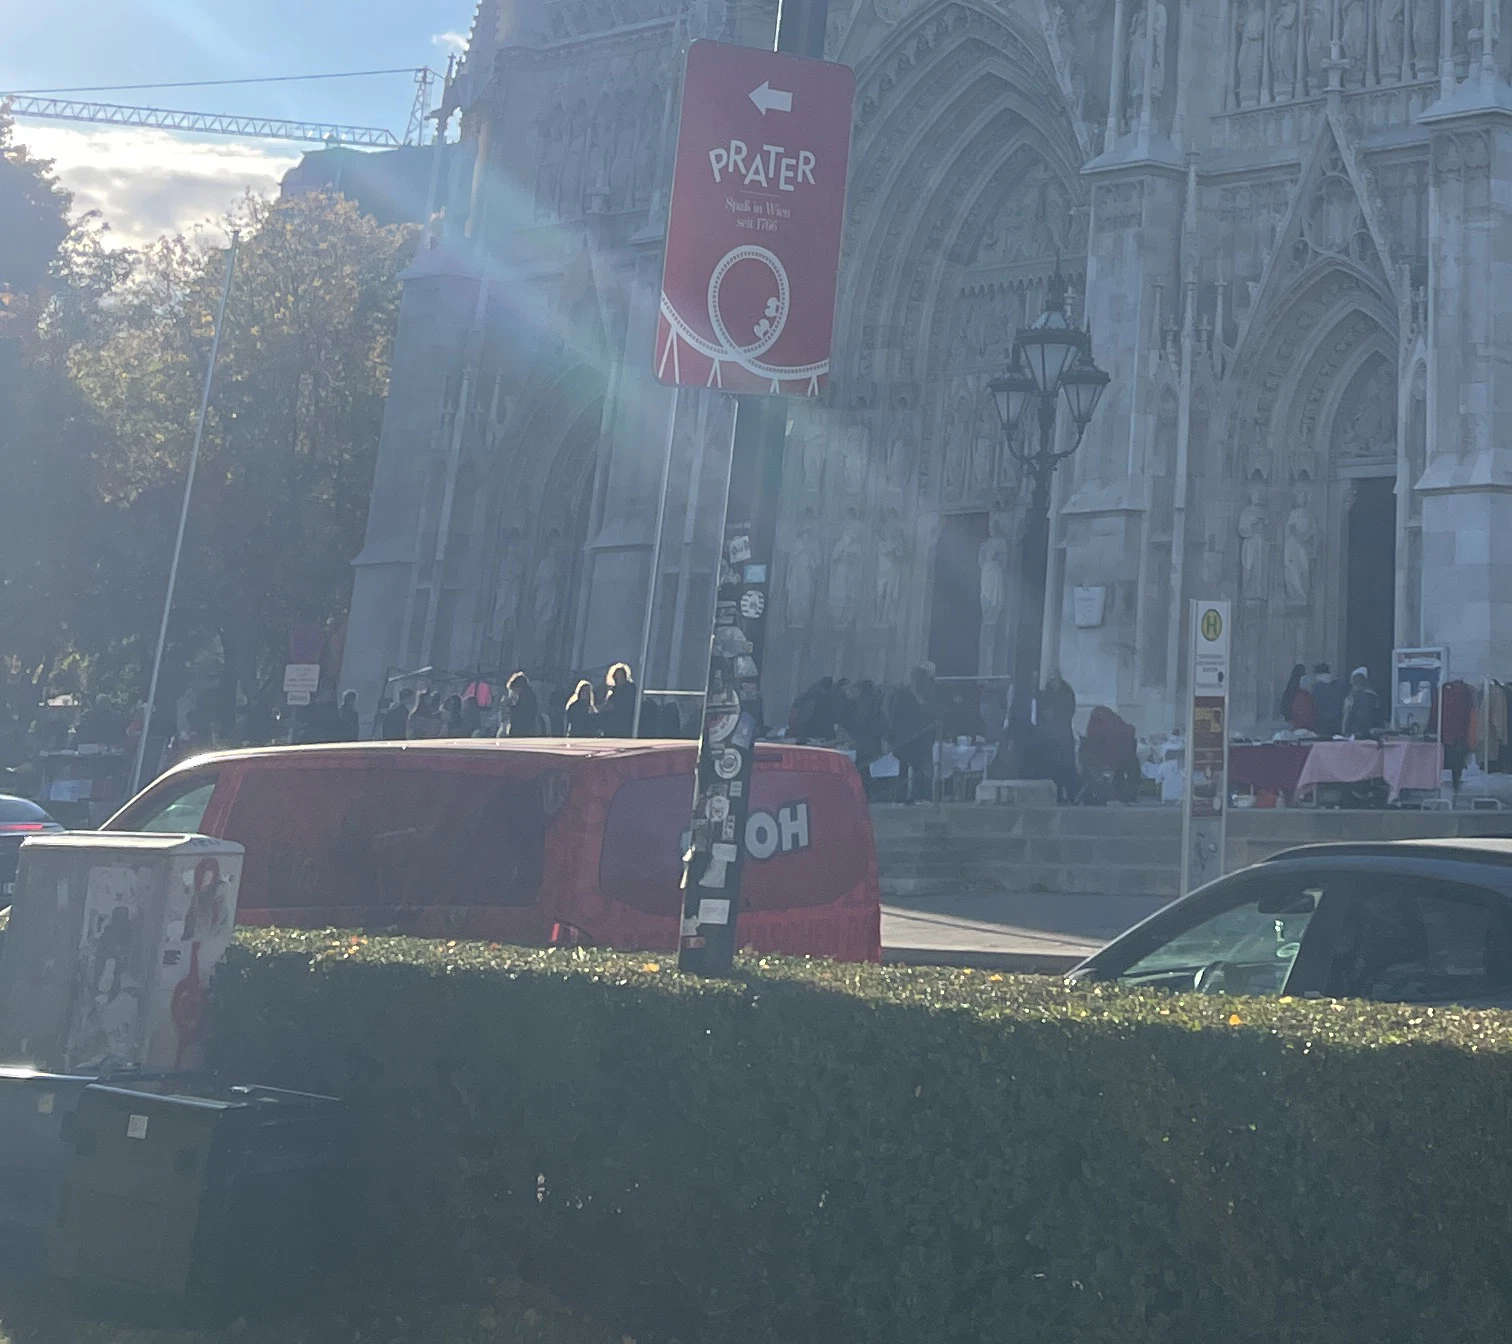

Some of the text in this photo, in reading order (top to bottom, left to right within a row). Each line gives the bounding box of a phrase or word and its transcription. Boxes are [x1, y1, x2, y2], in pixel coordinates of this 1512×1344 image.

[709, 139, 816, 191] PRATER
[766, 201, 791, 218] Wien
[744, 803, 809, 859] OH
